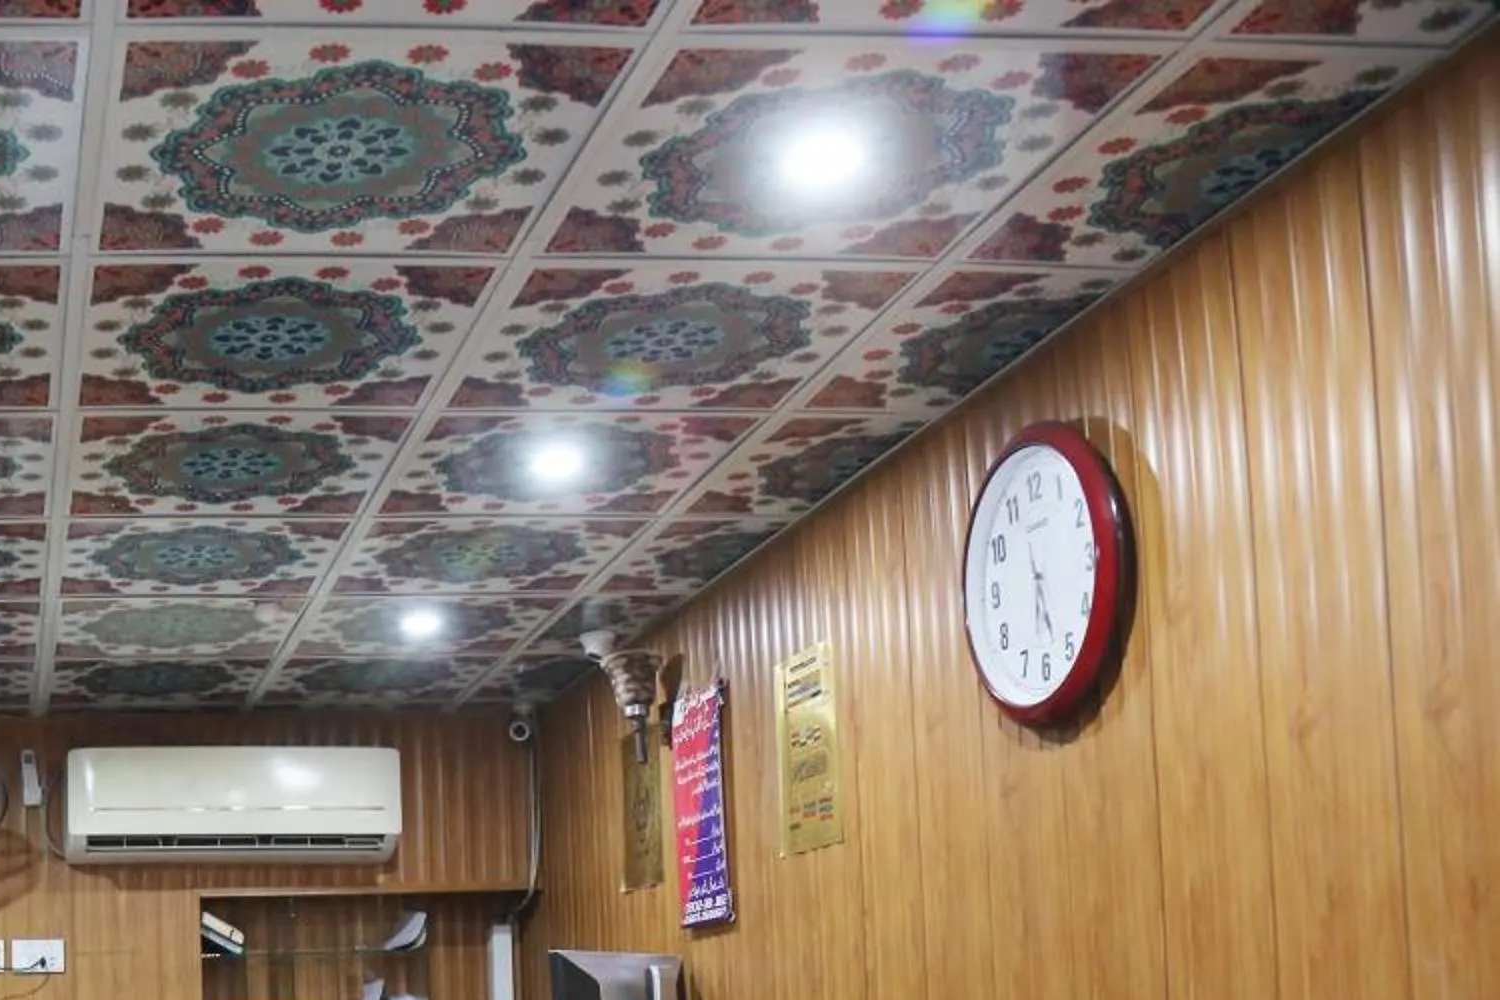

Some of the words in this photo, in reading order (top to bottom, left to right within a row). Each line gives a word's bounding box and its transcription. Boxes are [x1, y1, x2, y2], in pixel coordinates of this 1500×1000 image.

[1027, 471, 1042, 503] 12
[1057, 475, 1063, 499] 1
[1006, 495, 1019, 525] 11
[1076, 501, 1085, 528] 2
[992, 534, 1006, 563] 10
[1085, 541, 1094, 571] 3
[991, 582, 1001, 609] 9
[1081, 592, 1090, 616] 4
[999, 623, 1010, 650] 8
[1065, 632, 1074, 661] 5
[1020, 650, 1029, 678] 7
[1042, 653, 1051, 681] 6
